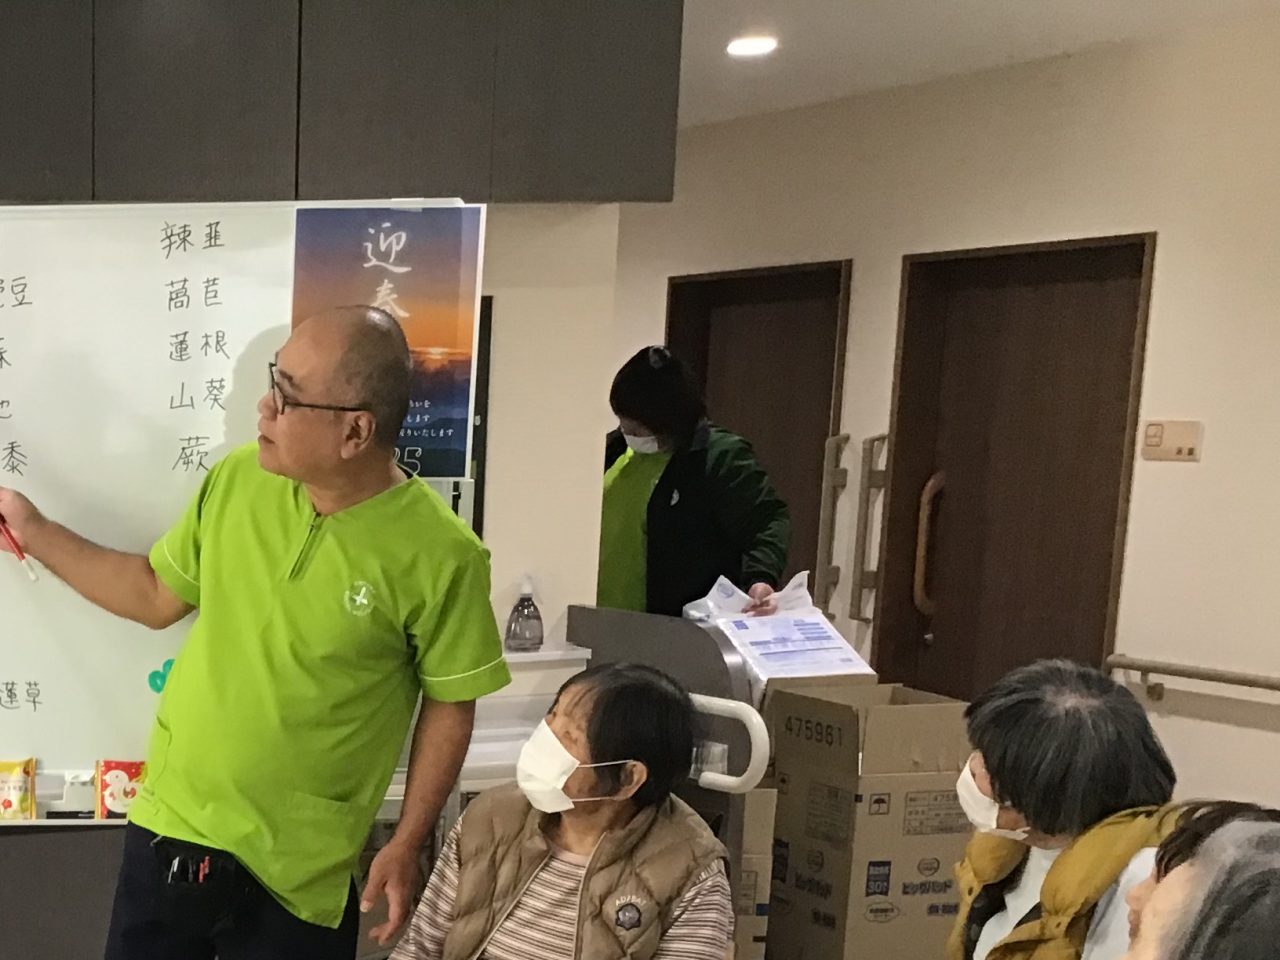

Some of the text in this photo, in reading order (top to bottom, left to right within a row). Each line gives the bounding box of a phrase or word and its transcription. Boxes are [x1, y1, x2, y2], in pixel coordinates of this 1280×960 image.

[169, 330, 231, 362] 蓮根
[169, 378, 227, 411] 山葵
[172, 436, 210, 472] 蕨
